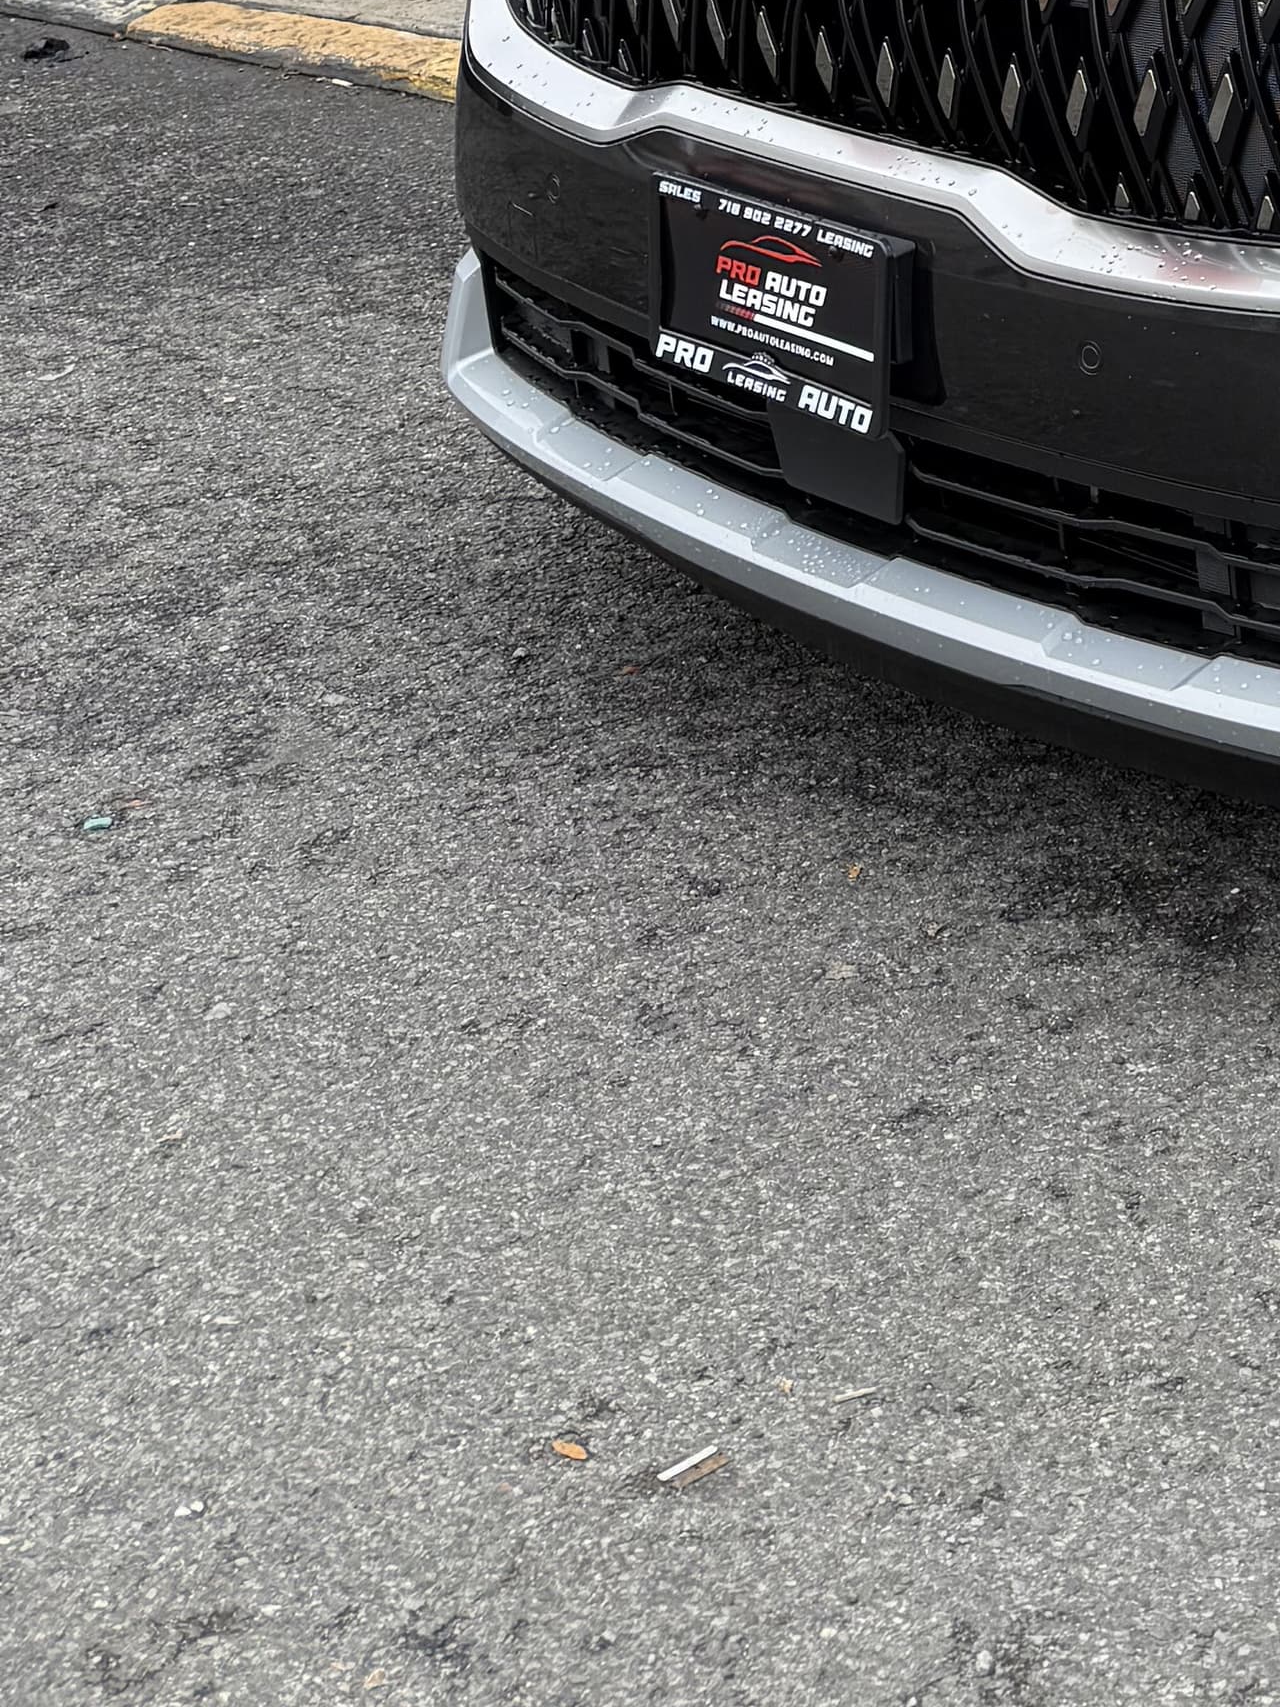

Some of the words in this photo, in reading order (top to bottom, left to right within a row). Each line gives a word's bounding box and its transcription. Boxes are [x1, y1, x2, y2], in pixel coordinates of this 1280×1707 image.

[658, 180, 702, 203] SALES
[717, 197, 740, 217] 718
[743, 204, 771, 226] 902
[773, 215, 813, 238] 2277
[816, 228, 875, 258] LEASING
[715, 255, 762, 287] PRO
[764, 270, 827, 307] AUTO
[719, 278, 816, 327] LEASING
[655, 332, 714, 373] PRO
[710, 315, 835, 367] WWW.PROAUTOLEASING.COM
[727, 370, 787, 403] LEASING
[798, 384, 873, 434] AUTO
